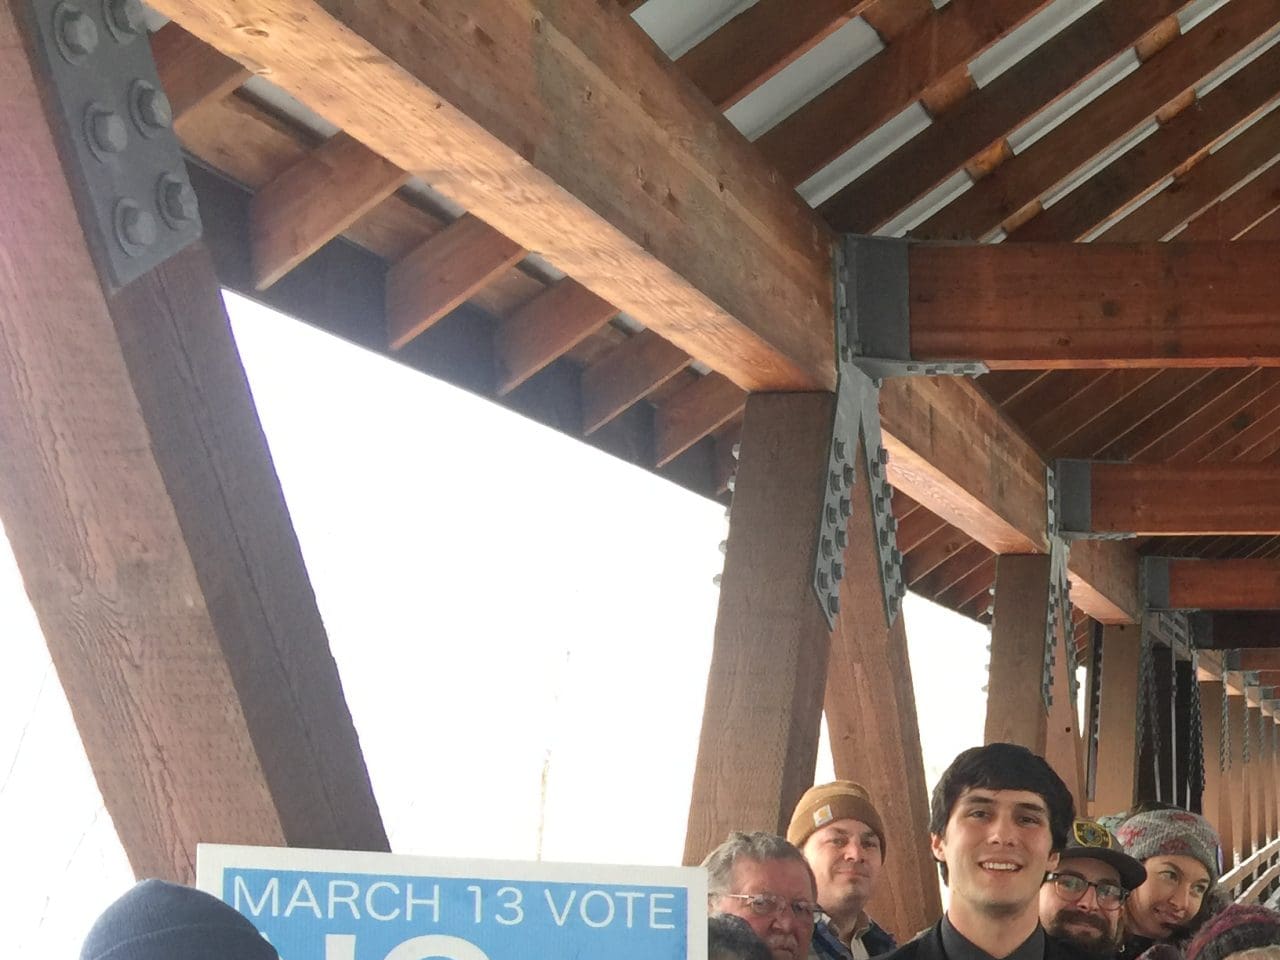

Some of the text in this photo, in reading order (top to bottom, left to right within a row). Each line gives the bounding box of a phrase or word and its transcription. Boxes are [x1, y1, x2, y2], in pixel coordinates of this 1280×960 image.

[233, 874, 676, 930] MARCH 13 VOTE
